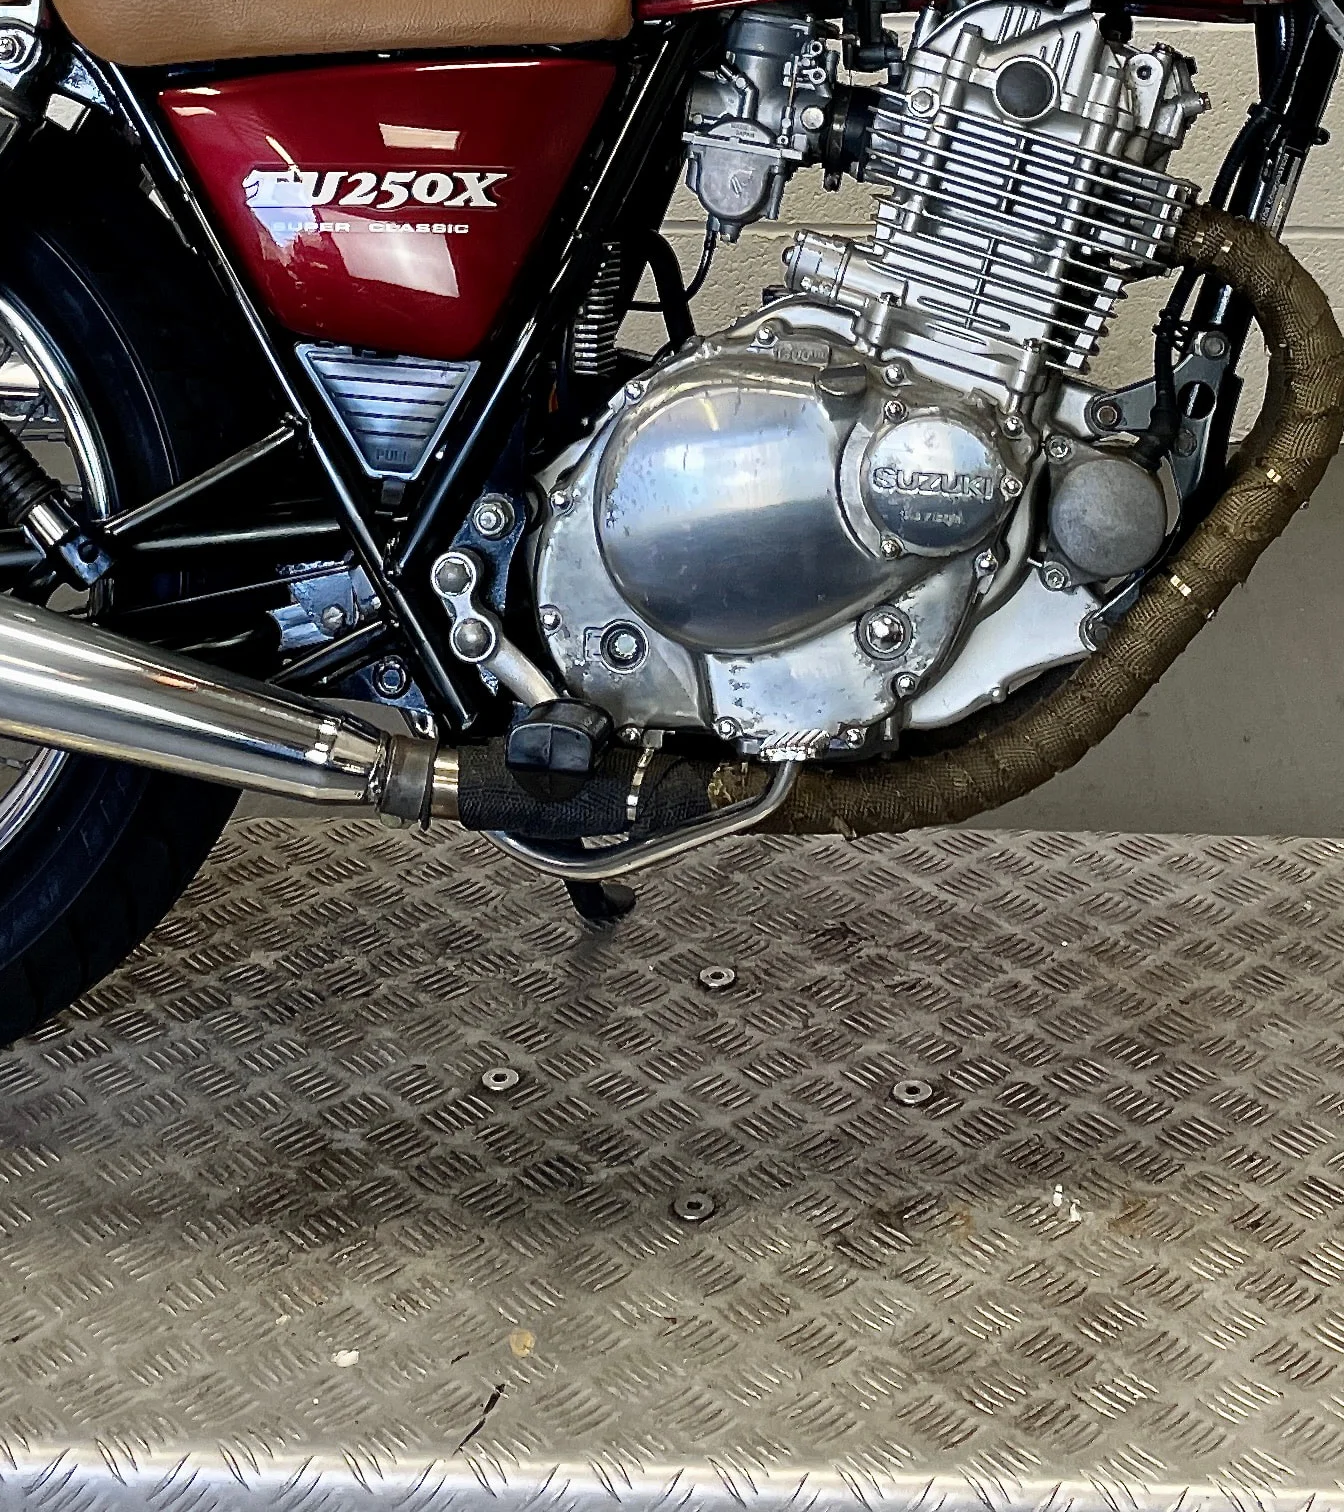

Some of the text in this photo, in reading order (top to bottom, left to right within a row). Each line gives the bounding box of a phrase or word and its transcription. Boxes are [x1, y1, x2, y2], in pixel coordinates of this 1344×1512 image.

[242, 170, 508, 210] TU250X
[273, 221, 470, 235] SUPER CLASSIC
[872, 466, 994, 500] SUZUKI
